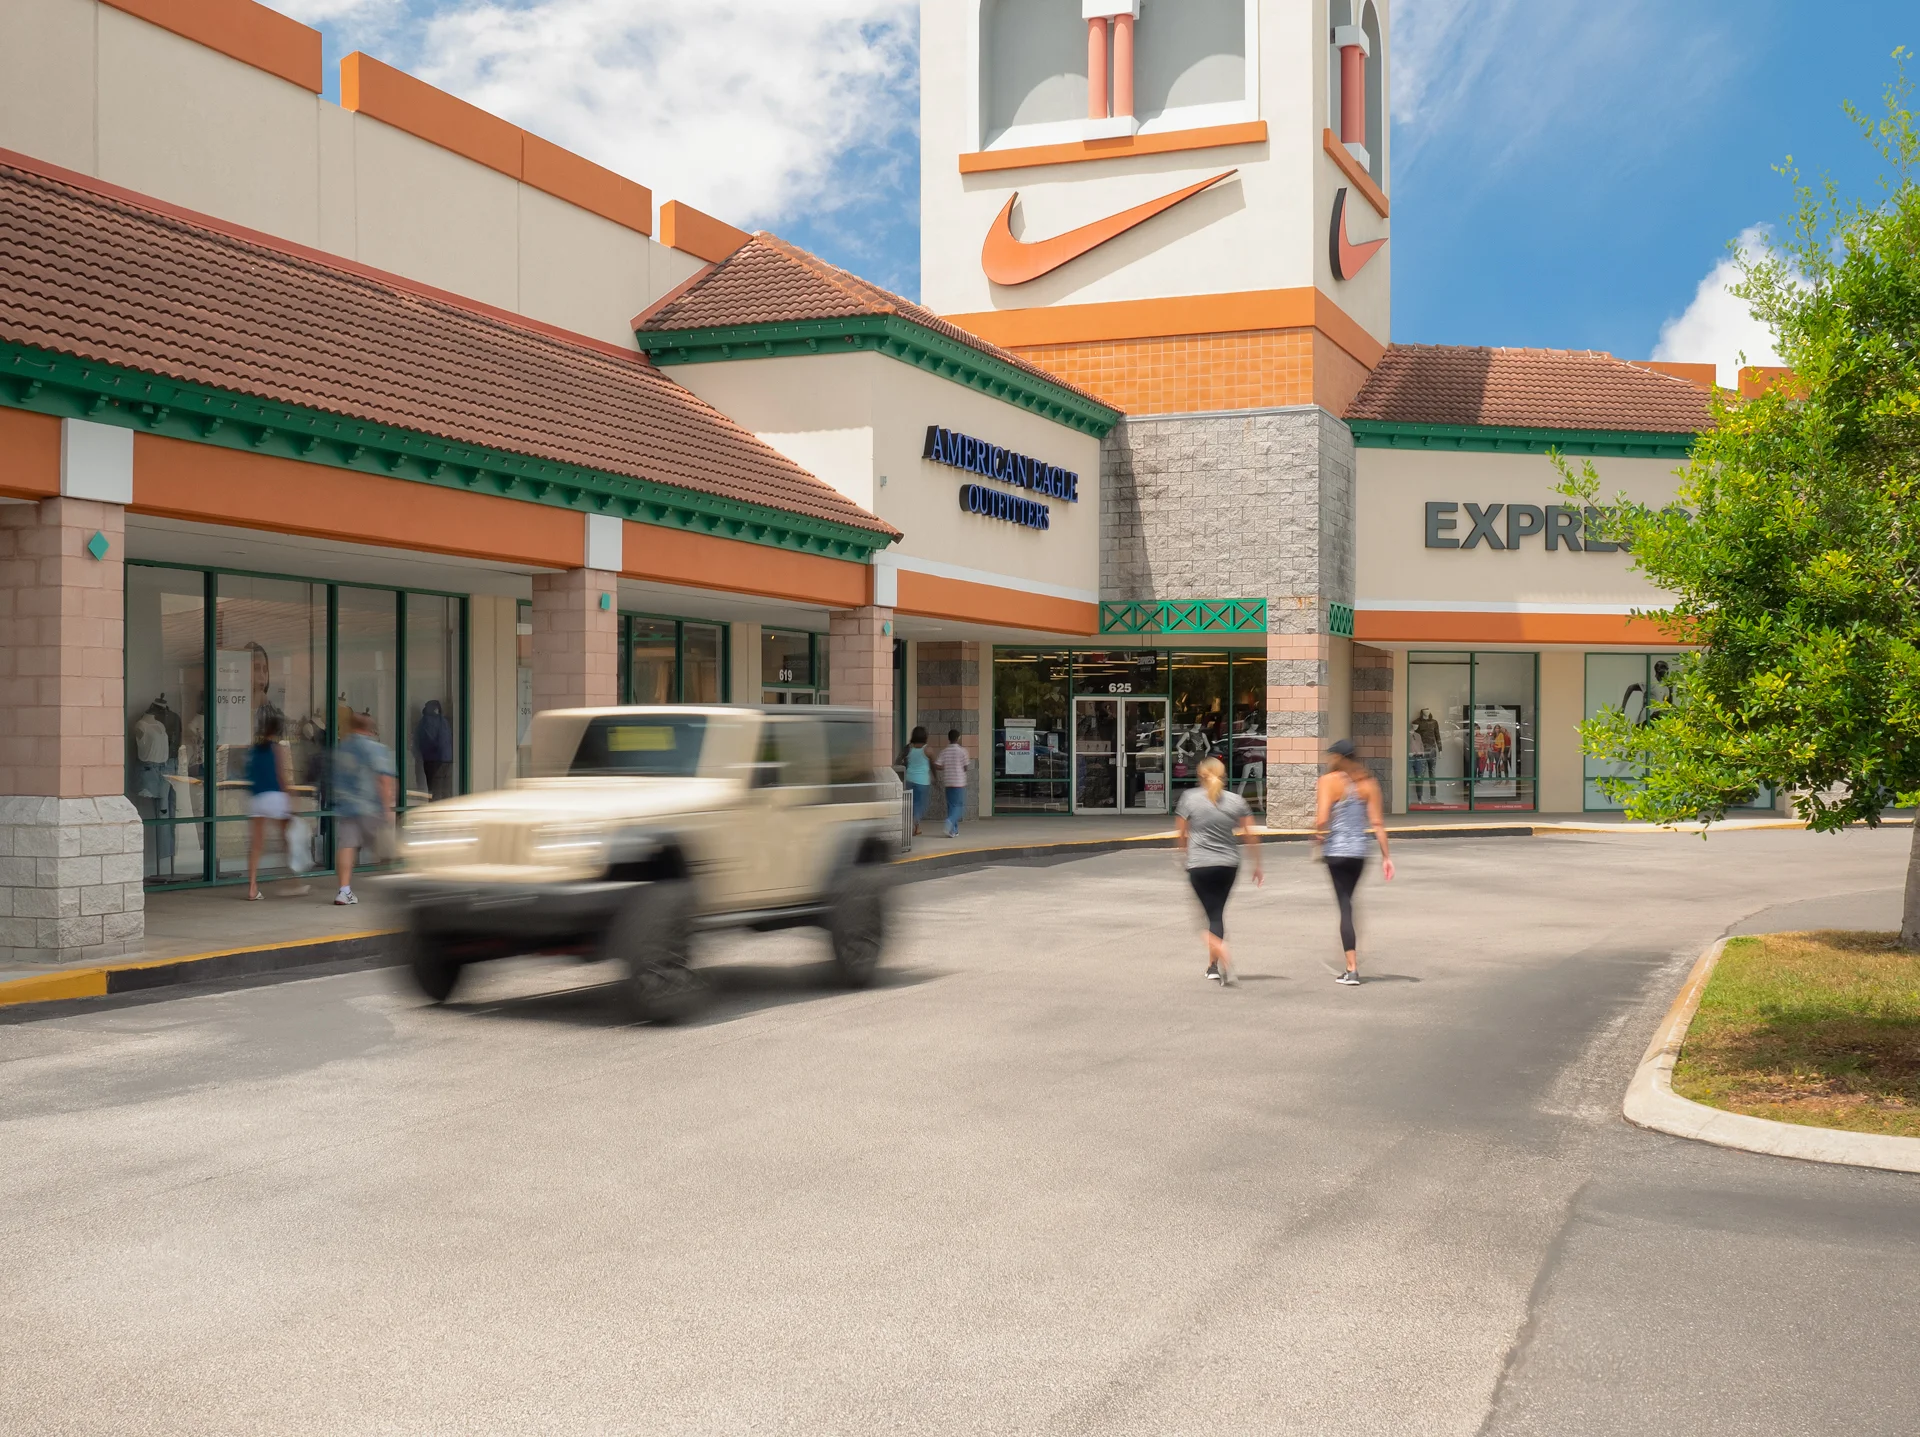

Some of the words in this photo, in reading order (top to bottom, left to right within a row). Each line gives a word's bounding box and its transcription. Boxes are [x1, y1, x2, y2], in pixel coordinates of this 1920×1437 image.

[928, 425, 1028, 489] AMERICAN
[1031, 458, 1078, 503] EAGLE
[963, 484, 1050, 530] OUTFITTERS
[779, 669, 793, 682] 619
[1108, 682, 1132, 693] 625
[217, 695, 229, 705] 0%
[231, 695, 246, 705] OFF
[520, 707, 532, 716] 50%
